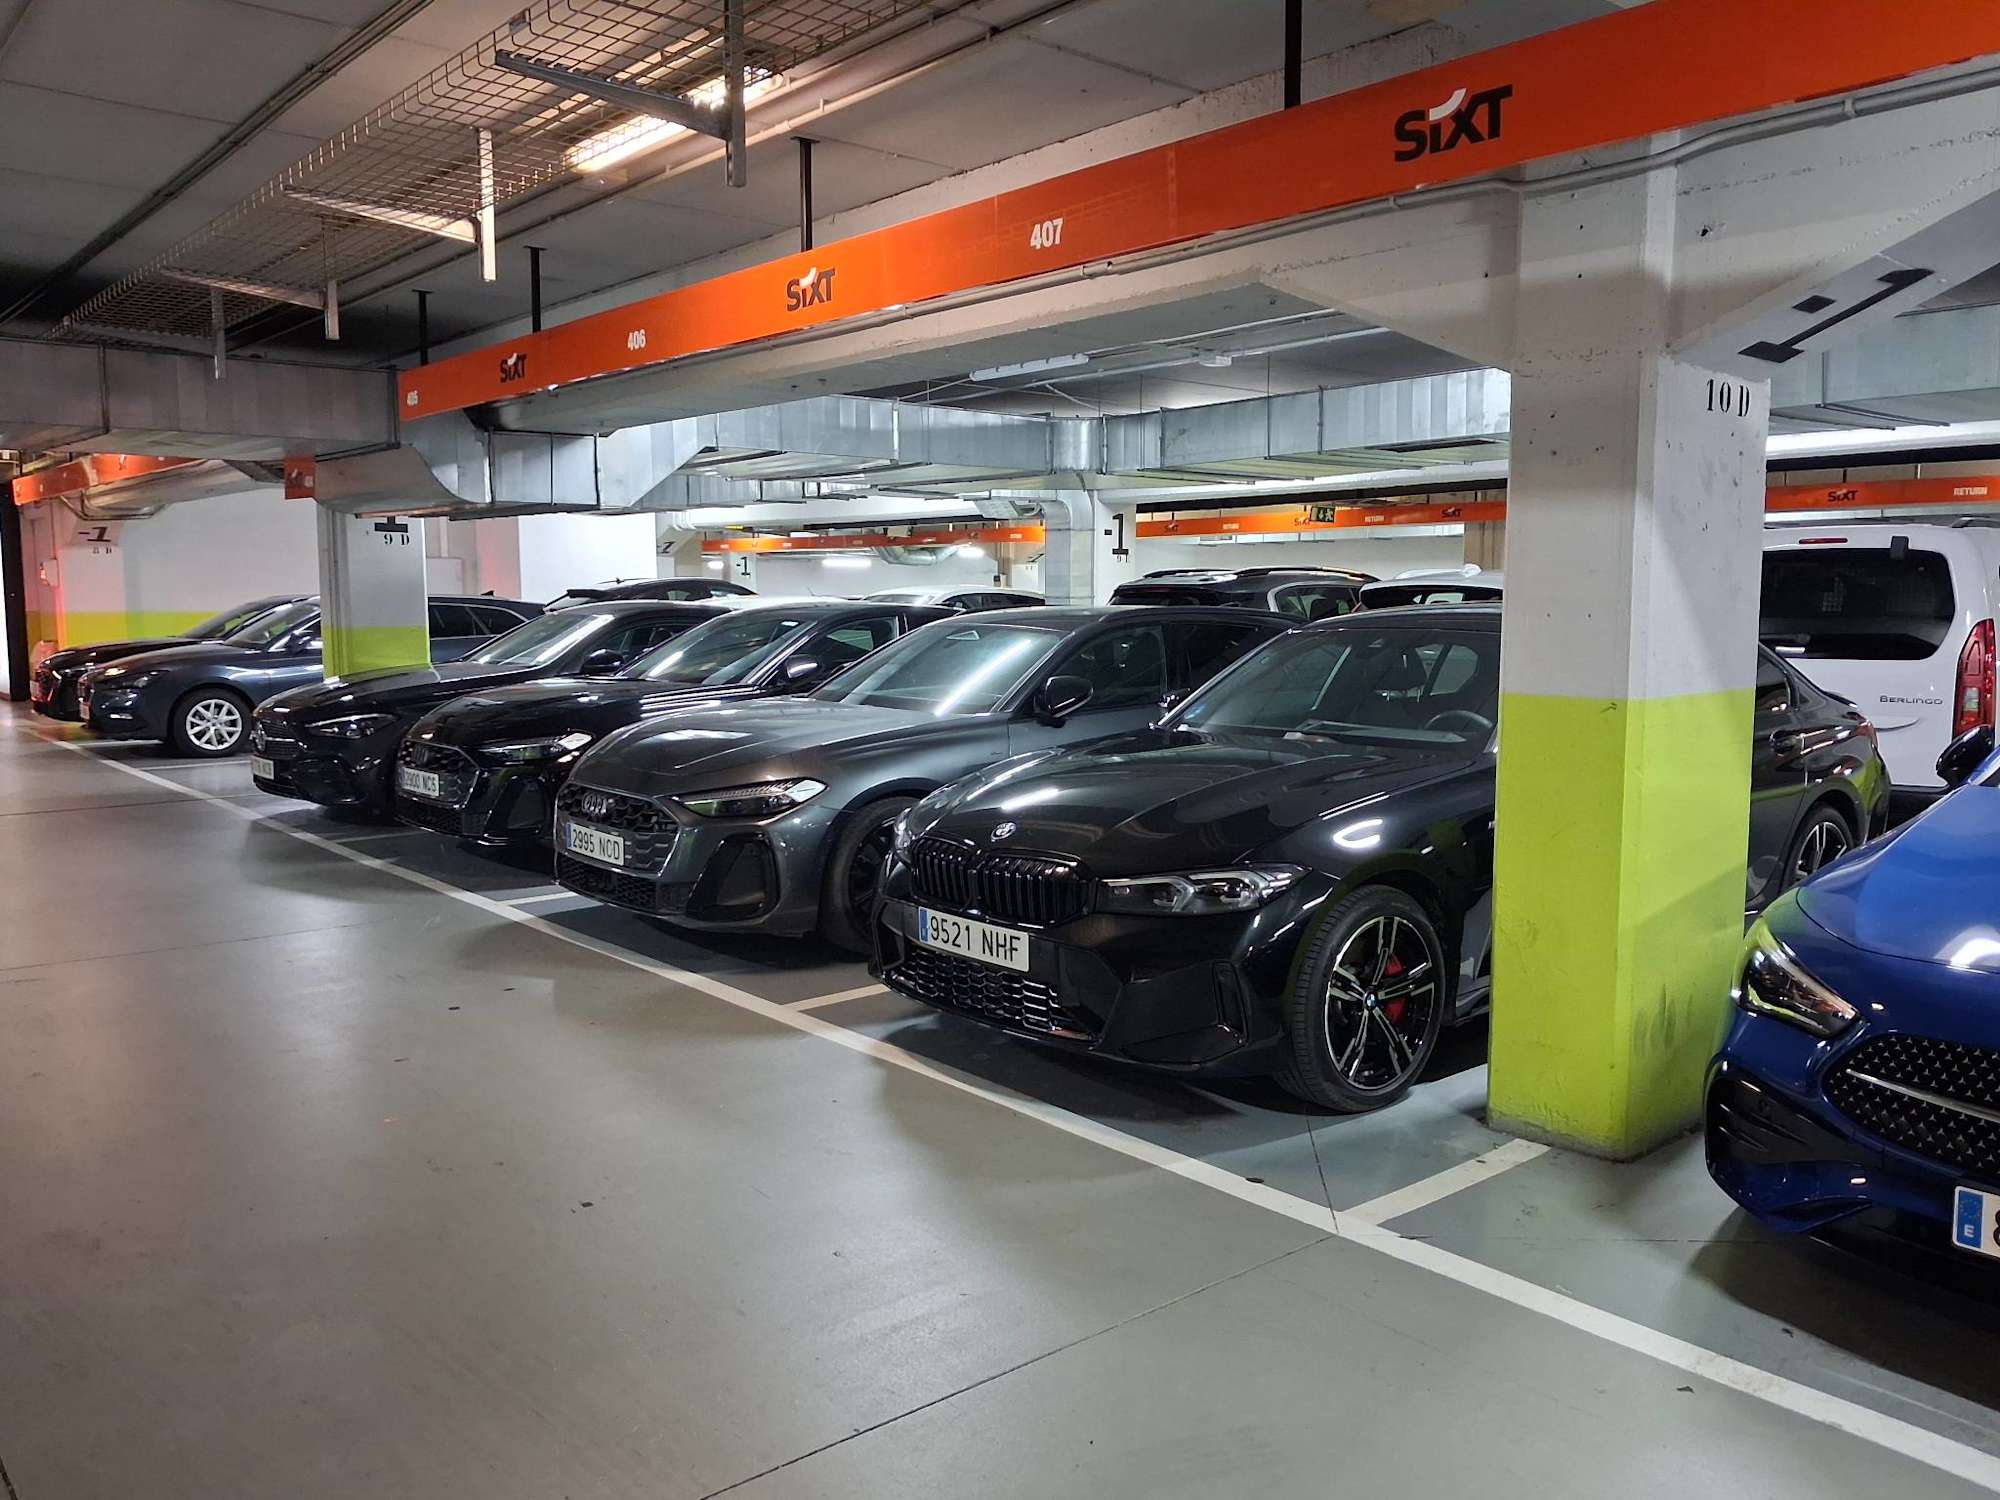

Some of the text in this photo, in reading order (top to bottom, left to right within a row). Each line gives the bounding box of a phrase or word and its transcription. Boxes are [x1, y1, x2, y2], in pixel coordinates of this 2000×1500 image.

[1394, 85, 1513, 162] SIXT
[1030, 218, 1064, 249] 407
[786, 266, 836, 311] SIXT
[627, 329, 646, 351] 406
[500, 352, 527, 383] SIXT
[1707, 379, 1750, 417] 10 D
[1827, 489, 1858, 502] SIXT
[1953, 487, 1988, 496] RETURN
[383, 533, 393, 545] 9
[1104, 513, 1129, 555] -1
[736, 556, 751, 576] -1
[1879, 695, 1943, 705] BERLINGO
[573, 829, 620, 860] 2995 NCD
[930, 916, 1021, 962] 9521 NHF
[1963, 1224, 1975, 1238] E
